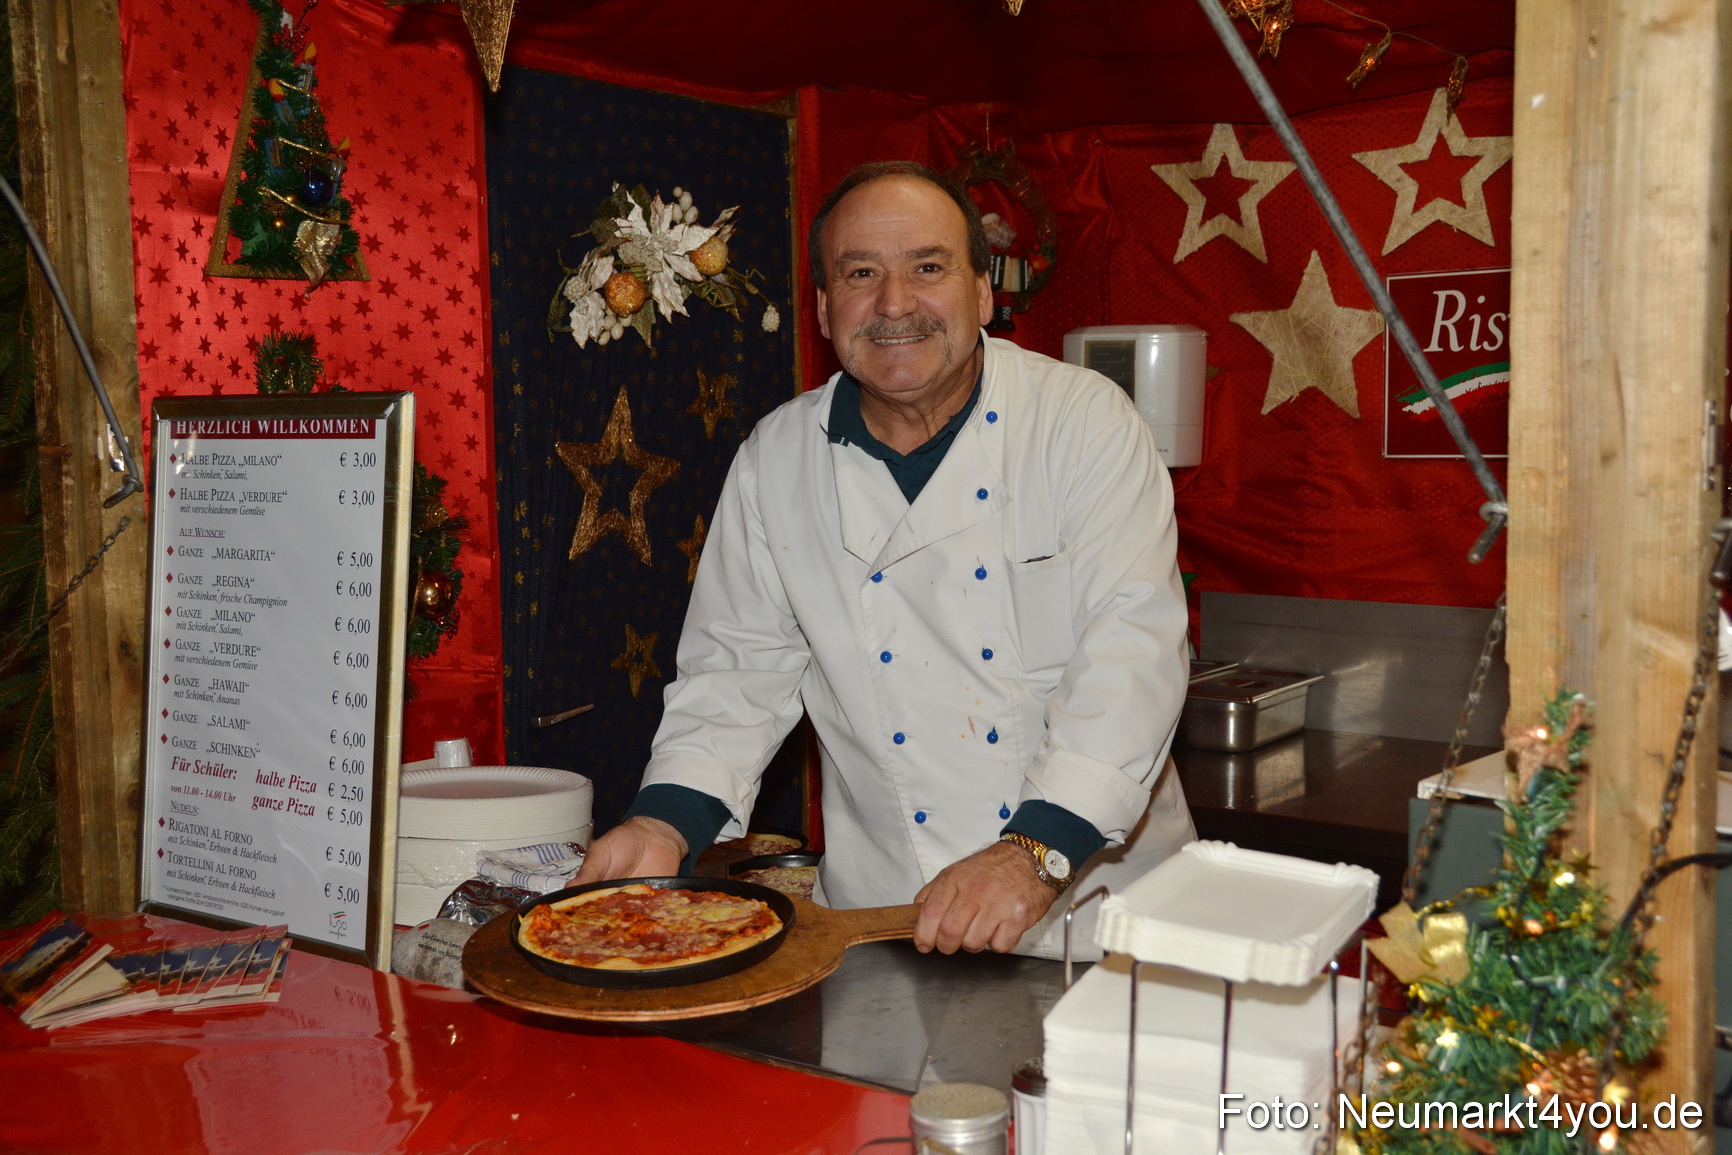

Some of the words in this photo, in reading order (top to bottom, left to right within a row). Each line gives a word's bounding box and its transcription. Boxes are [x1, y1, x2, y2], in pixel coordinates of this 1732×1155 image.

[1423, 290, 1510, 352] Ris
[176, 420, 251, 434] HERZLICH
[257, 419, 370, 434] WILLKOMMEN
[212, 453, 236, 466] PIZZA
[340, 452, 347, 467] €
[353, 452, 377, 470] 3,00
[224, 470, 248, 481] Salami,
[180, 487, 209, 501] HALBE
[211, 488, 235, 502] PIZZA
[338, 489, 346, 505] €
[352, 490, 375, 508] 3,00
[180, 504, 191, 513] mit
[192, 504, 238, 515] verschiedenem
[239, 505, 266, 516] Gemüse
[179, 527, 193, 536] AUF
[194, 527, 226, 538] WUNSCH:
[178, 545, 204, 558] GANZE
[337, 551, 344, 566] €
[350, 551, 373, 569] 5,00
[177, 573, 203, 585] GANZE
[336, 580, 343, 595] €
[349, 581, 372, 599] 6,00
[177, 590, 188, 599] mit
[218, 591, 242, 604] frische
[176, 606, 202, 619] GANZE
[335, 617, 342, 632] €
[347, 617, 371, 635] 6,00
[176, 621, 187, 630] mit
[218, 623, 243, 636] Salami,
[174, 654, 185, 662] mit
[186, 655, 231, 667] verschiedenem
[232, 659, 259, 670] Gemüse
[175, 638, 201, 651] GANZE
[333, 650, 340, 665] €
[346, 651, 369, 670] 6,00
[173, 689, 184, 698] mit
[216, 694, 241, 706] Ananas
[174, 674, 200, 687] GANZE
[332, 690, 339, 705] €
[345, 691, 368, 710] 6,00
[172, 710, 199, 724] GANZE
[330, 729, 337, 744] €
[343, 731, 366, 749] 6,00
[171, 736, 198, 750] GANZE
[329, 756, 336, 771] €
[341, 757, 365, 775] 6,00
[171, 755, 191, 772] Für
[192, 759, 238, 780] Schüler:
[255, 769, 286, 788] halbe
[287, 774, 318, 793] Pizza
[328, 782, 335, 797] €
[341, 784, 364, 802] 2,50
[170, 785, 182, 794] von
[183, 785, 200, 796] 11.00
[205, 788, 223, 800] 14.00
[223, 790, 237, 803] Uhr
[170, 800, 200, 816] NUDELN:
[251, 795, 284, 811] ganze
[286, 797, 316, 817] Pizza
[327, 806, 335, 821] €
[340, 808, 363, 827] 5,00
[167, 835, 178, 844] mit
[209, 841, 231, 854] Erbsen
[232, 847, 239, 856] &
[240, 847, 278, 863] Hackfleisch
[168, 818, 209, 837] RIGATONI
[211, 828, 222, 840] AL
[224, 830, 253, 846] FORNO
[326, 846, 333, 862] €
[339, 848, 362, 867] 5,00
[166, 869, 177, 878] mit
[208, 876, 230, 890] Erbsen
[231, 882, 237, 891] &
[238, 882, 276, 899] Hackfleisch
[167, 850, 214, 872] TORTELLINI
[215, 864, 227, 875] AL
[228, 865, 257, 880] FORNO
[324, 882, 332, 898] €
[337, 885, 360, 904] 5,00
